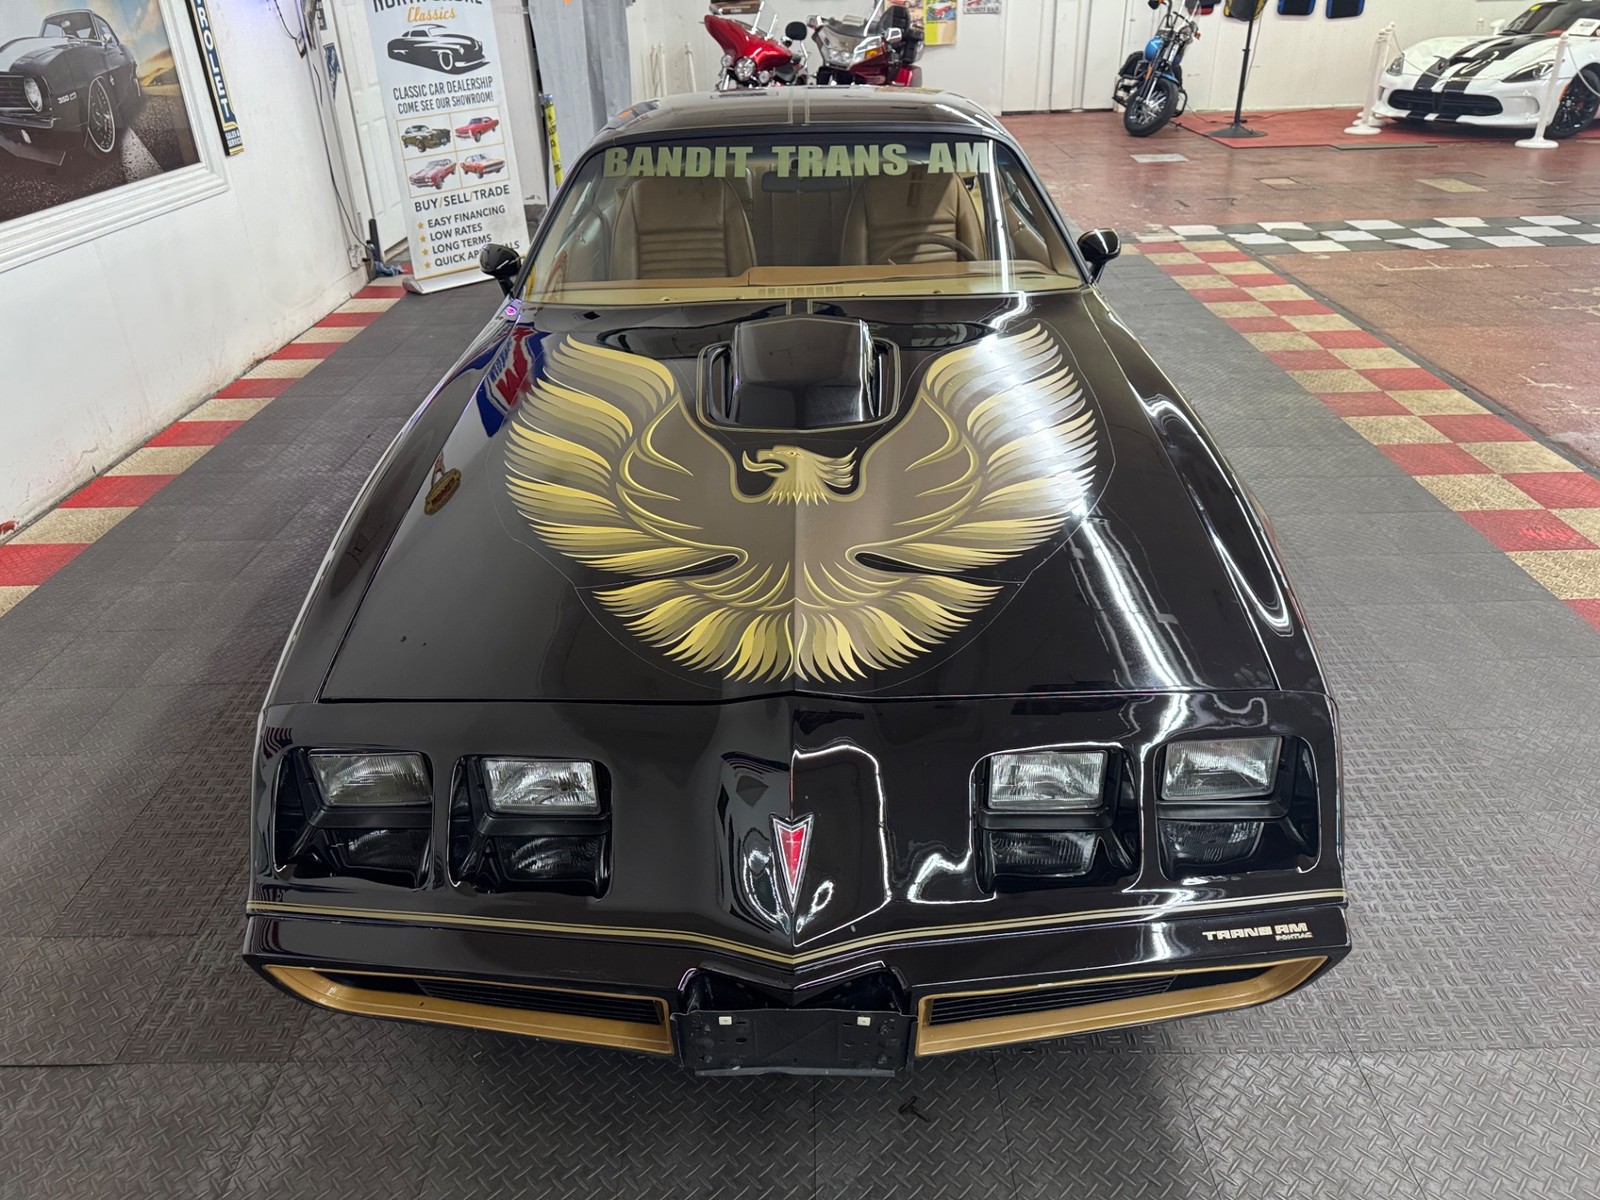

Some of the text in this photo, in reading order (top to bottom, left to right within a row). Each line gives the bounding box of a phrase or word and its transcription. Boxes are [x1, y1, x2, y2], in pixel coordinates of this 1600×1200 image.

[407, 7, 456, 22] Classics
[393, 76, 493, 100] CLASSIC CAR DEALERSHIP
[398, 101, 419, 114] COME
[420, 99, 434, 112] SEE
[435, 96, 451, 110] OUR
[603, 142, 989, 178] BANDIT TRANS AM
[427, 205, 505, 229] EASY FINANCING
[429, 222, 483, 242] LOW RATES
[432, 233, 492, 255] LONG TERMS
[434, 253, 466, 267] QUICK
[1202, 922, 1308, 940] TRANS AM
[1275, 932, 1313, 941] PONTIAC
